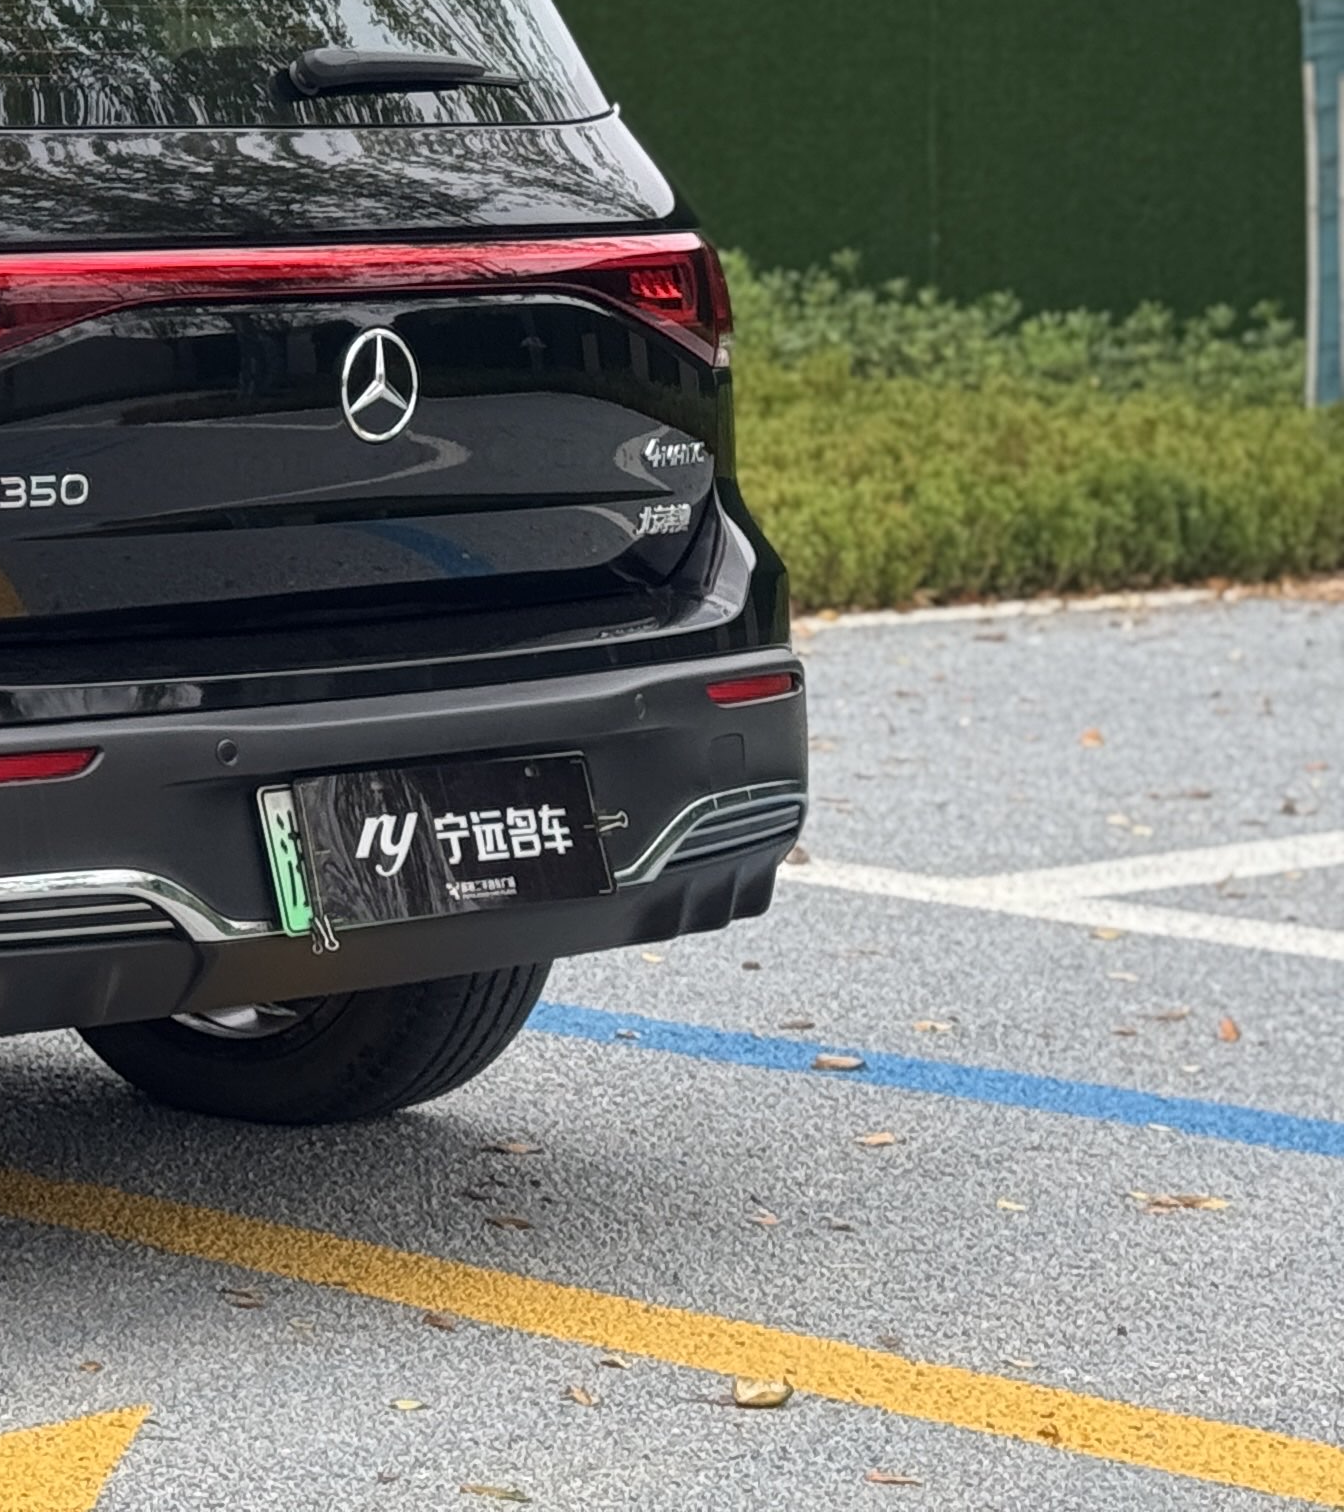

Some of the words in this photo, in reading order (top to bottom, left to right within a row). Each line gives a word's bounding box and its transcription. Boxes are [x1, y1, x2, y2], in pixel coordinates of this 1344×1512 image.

[0, 473, 89, 509] 350
[434, 803, 573, 865] 宁远名车
